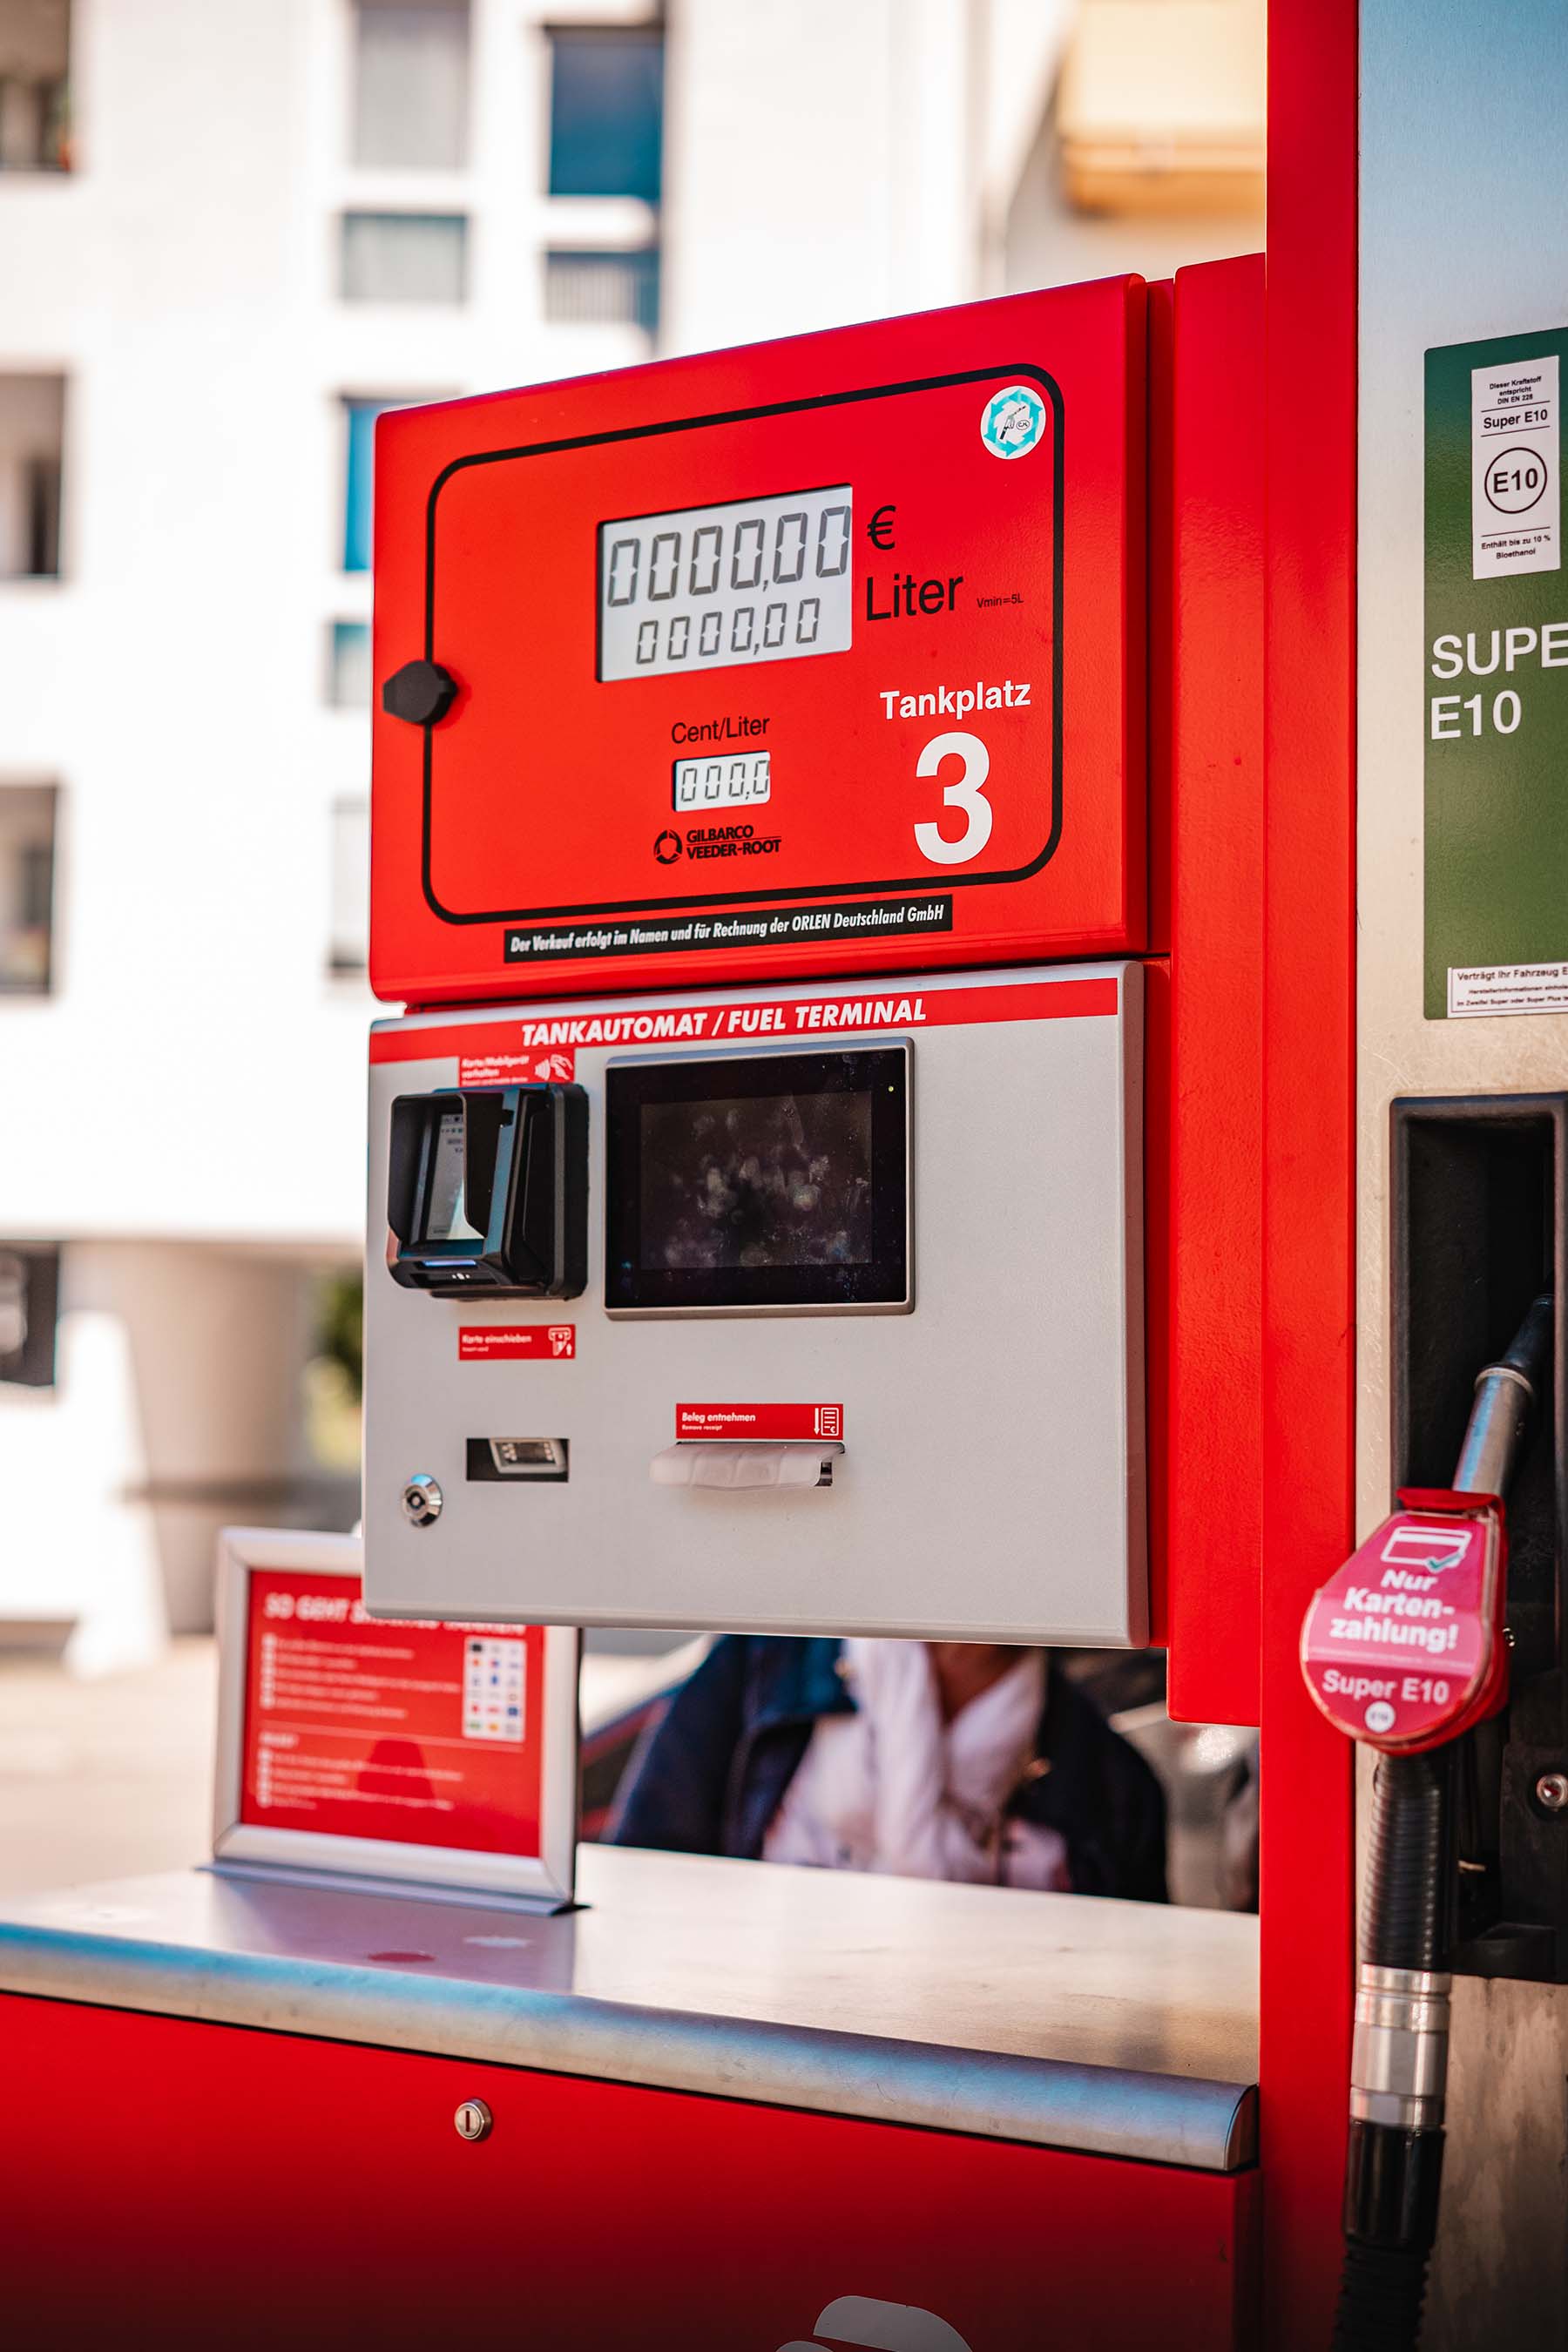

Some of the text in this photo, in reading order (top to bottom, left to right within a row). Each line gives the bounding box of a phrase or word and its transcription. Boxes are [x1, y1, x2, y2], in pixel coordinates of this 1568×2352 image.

[1489, 375, 1542, 390] Dieser Kraftstoff
[1499, 386, 1532, 396] entspricht
[1484, 409, 1548, 429] Super E10
[1493, 468, 1538, 494] E10
[867, 504, 896, 550] €
[1481, 540, 1507, 550] Enthält
[1496, 548, 1537, 559] Bioethanol
[866, 573, 964, 621] Liter
[977, 592, 1024, 608] Vmin=5L
[880, 680, 1031, 721] Tankplatz
[1431, 690, 1522, 740] E10
[672, 716, 770, 744] Cent/Liter
[913, 732, 993, 865] 3
[686, 825, 754, 843] GILBARCO
[686, 840, 782, 860] VEEDER-ROOT
[510, 904, 944, 952] Der Verkauf erfolgt im Namen und für Rechnung der ORLEN Deutschland GmbH
[1457, 971, 1496, 981] Verträgt
[1498, 970, 1511, 979] Ihr
[1514, 969, 1558, 977] Fahrzeug
[523, 998, 926, 1047] TANKAUTOMAT / FUEL TERMINAL
[462, 1333, 532, 1344] Karte einschieben
[681, 1412, 756, 1423] Beleg entnehmen
[703, 1423, 723, 1432] receipt
[1382, 1570, 1437, 1591] Nur
[1342, 1586, 1456, 1619] Karten-
[1329, 1617, 1458, 1652] zahlung!
[1323, 1669, 1448, 1704] Super E10
